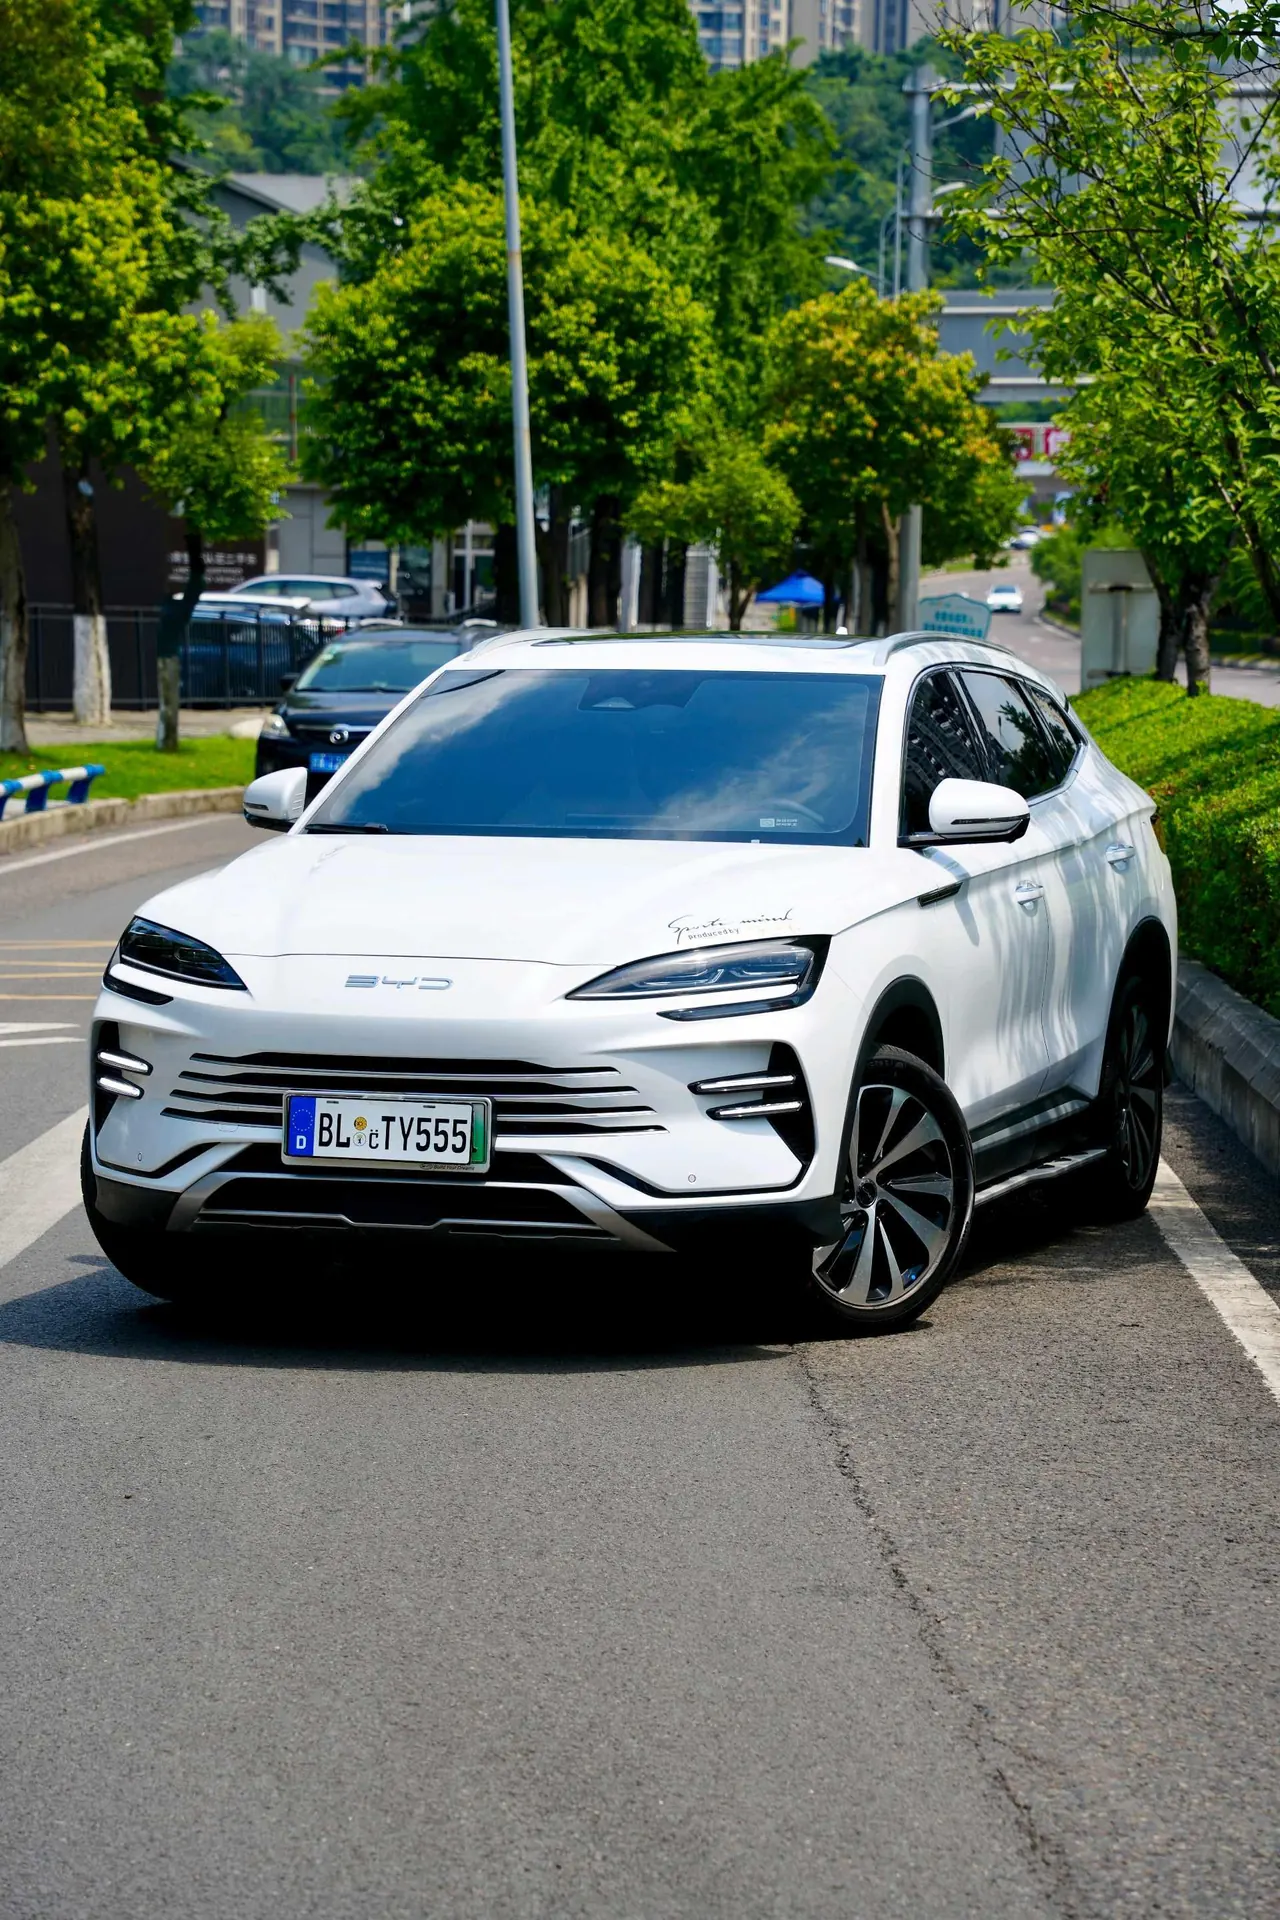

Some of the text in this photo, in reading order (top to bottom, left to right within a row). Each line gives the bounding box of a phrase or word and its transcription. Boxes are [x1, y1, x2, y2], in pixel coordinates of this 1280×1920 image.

[344, 974, 454, 991] BYD
[318, 1112, 351, 1148] BL
[296, 1134, 307, 1150] D
